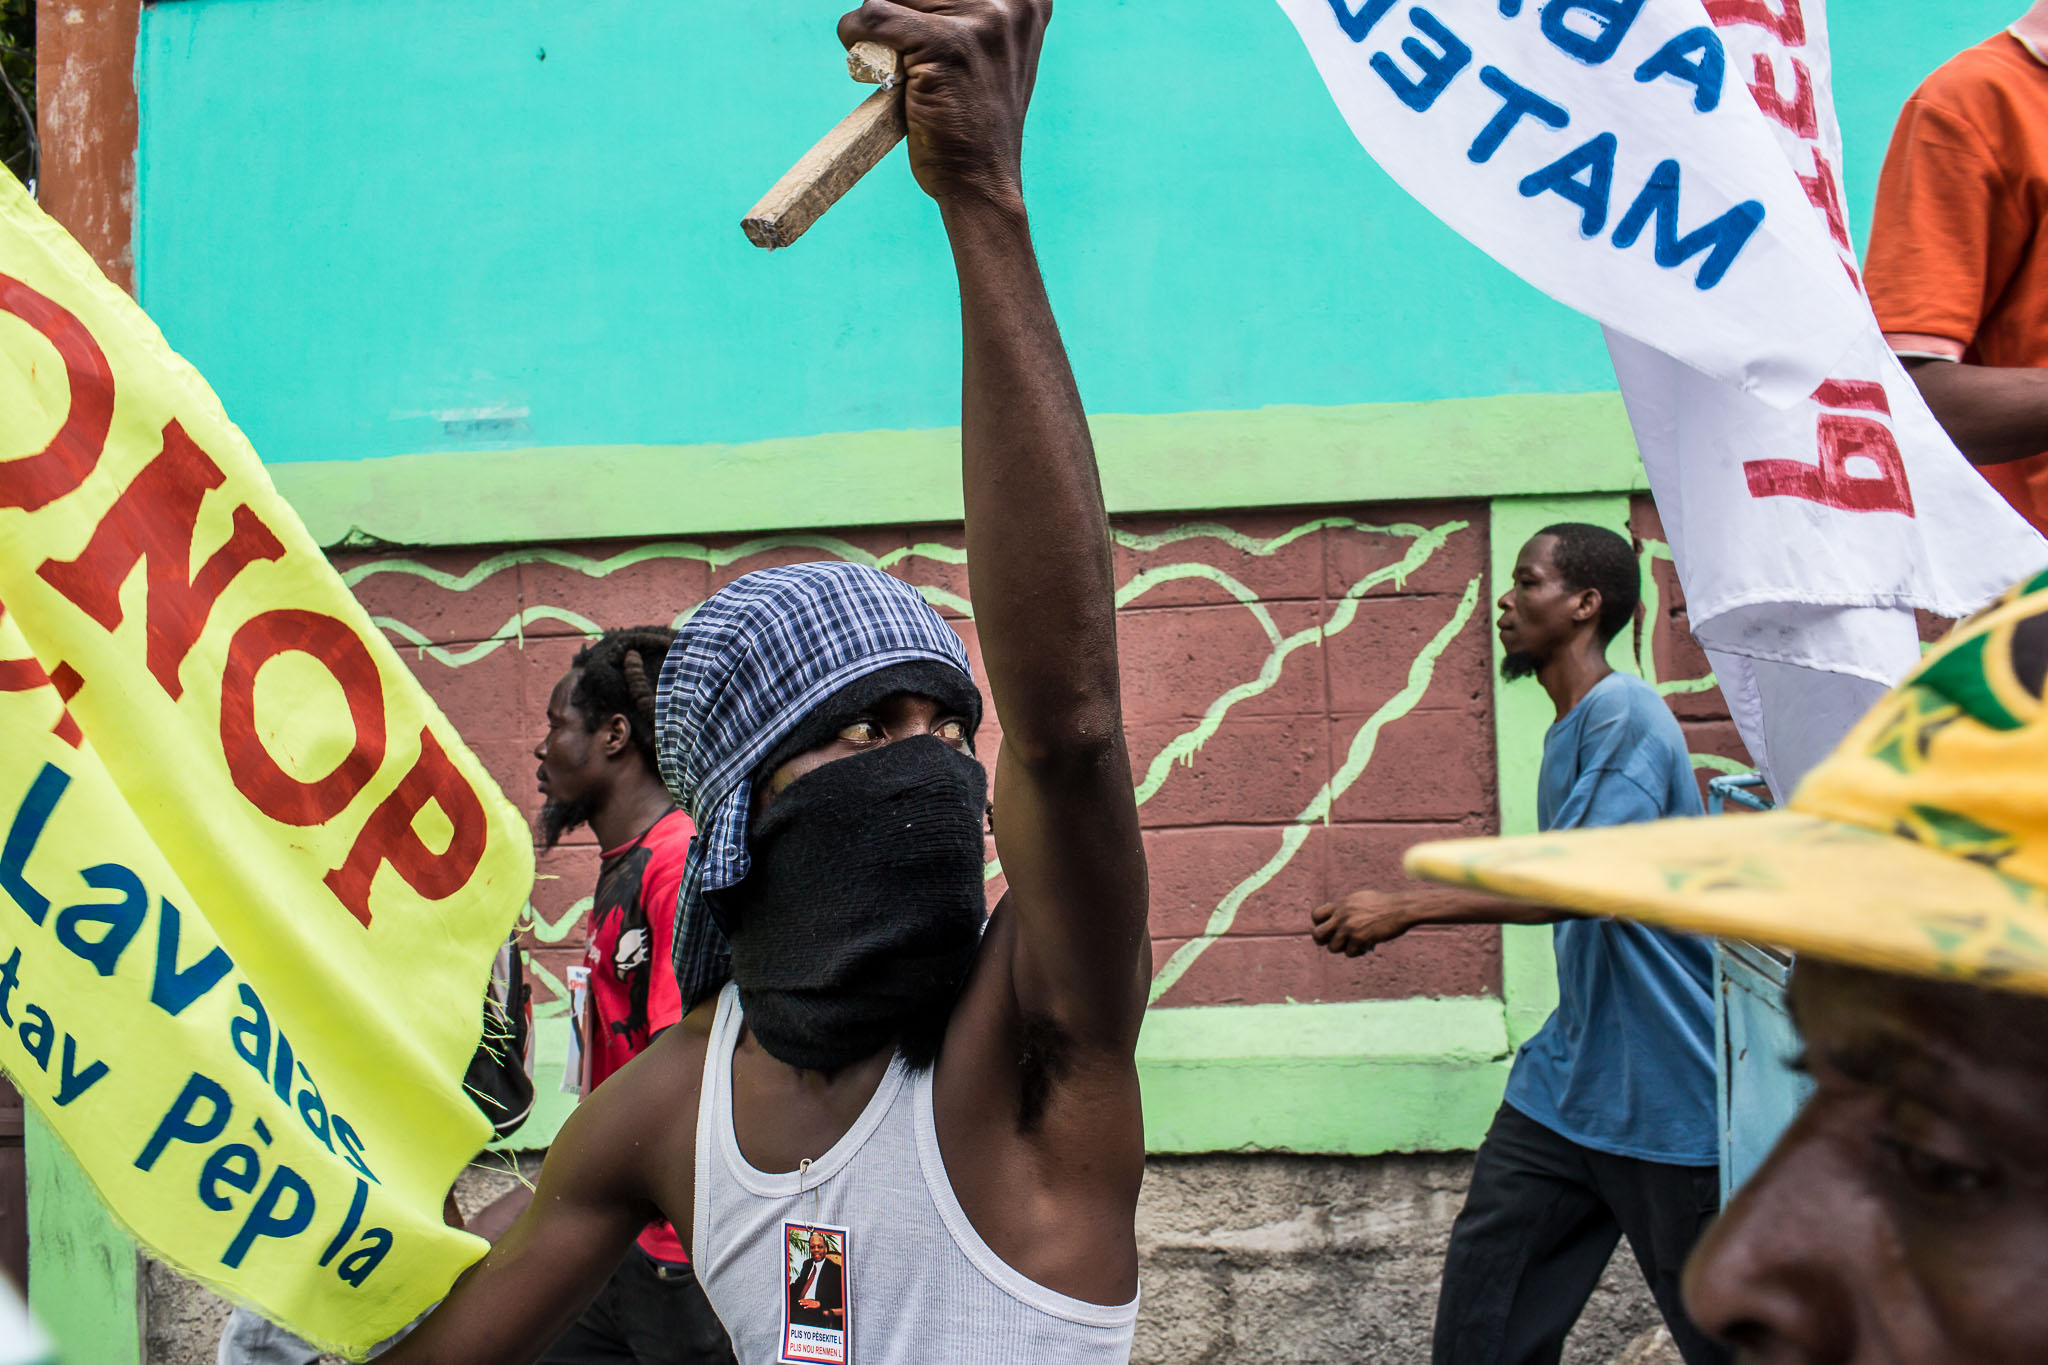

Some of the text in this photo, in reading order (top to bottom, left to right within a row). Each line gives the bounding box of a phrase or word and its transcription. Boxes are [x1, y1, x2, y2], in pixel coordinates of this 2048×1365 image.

[0, 761, 381, 1185] Lavalas
[318, 1177, 393, 1288] la
[790, 1330, 802, 1339] PLIS
[804, 1331, 811, 1340] YO
[790, 1343, 801, 1352] PLIS
[803, 1344, 814, 1353] NOU
[816, 1346, 837, 1356] RENMEN
